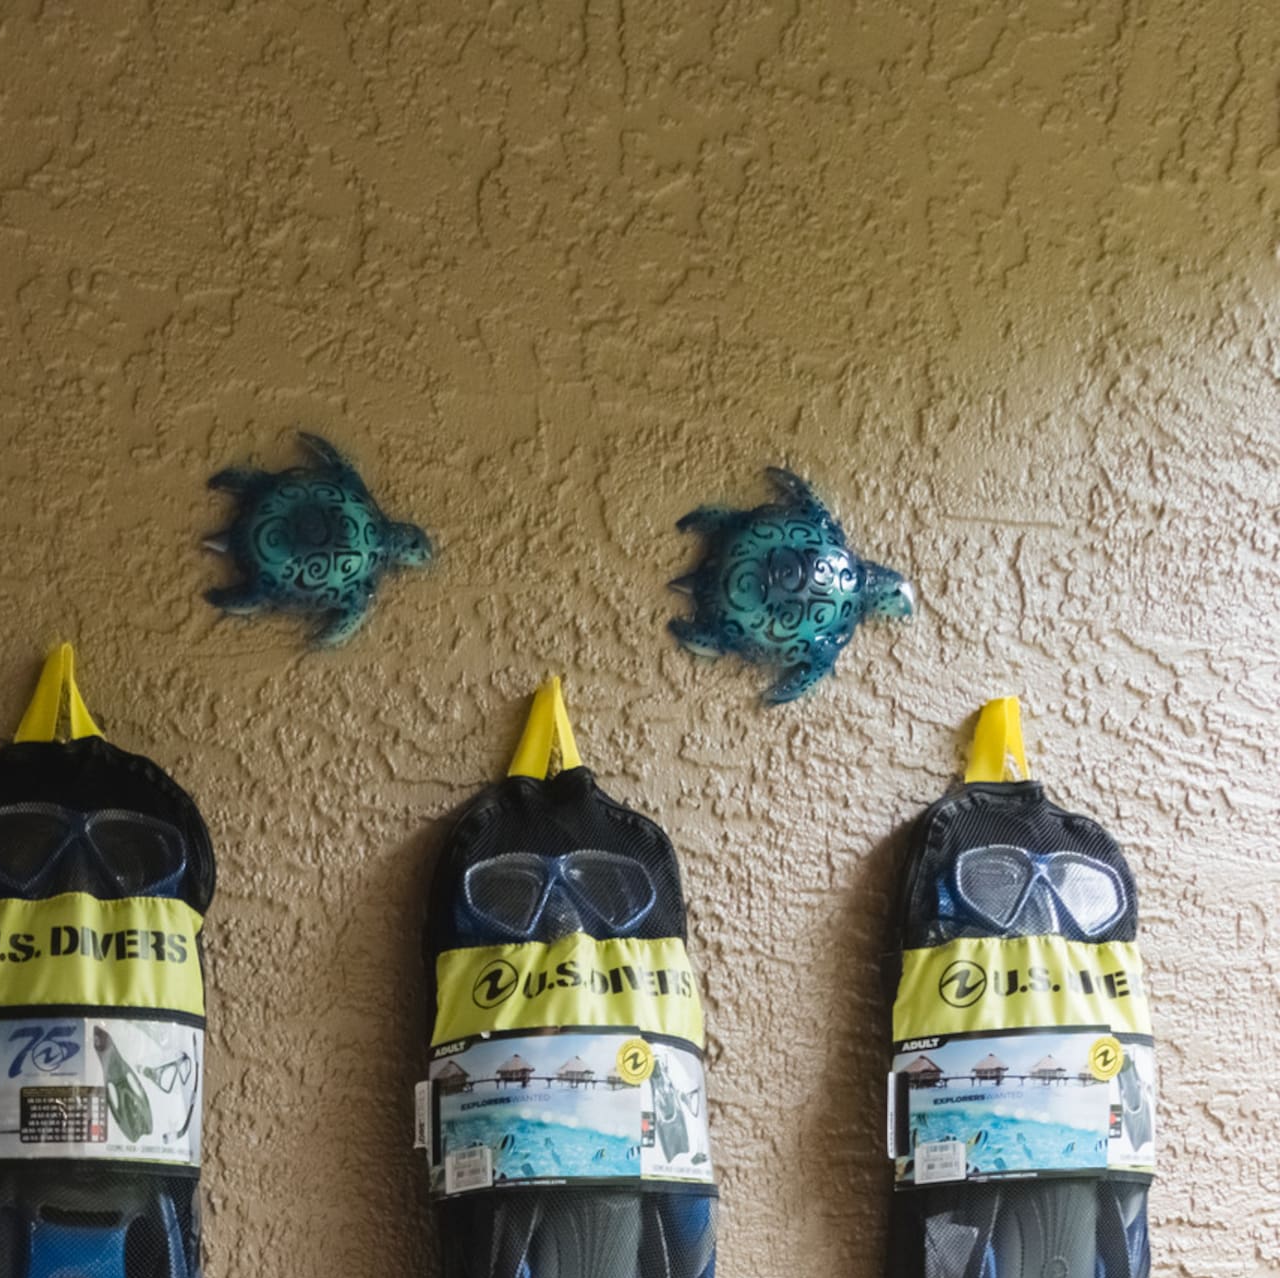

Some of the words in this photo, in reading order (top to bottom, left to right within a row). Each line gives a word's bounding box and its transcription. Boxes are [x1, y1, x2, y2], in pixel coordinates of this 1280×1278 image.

[50, 925, 188, 964] DIVERS
[522, 960, 588, 999] U.S.
[591, 966, 692, 998] DIVERS
[993, 967, 1060, 997] U.S.
[434, 1041, 466, 1057] ADULT
[902, 1038, 940, 1051] ADULT
